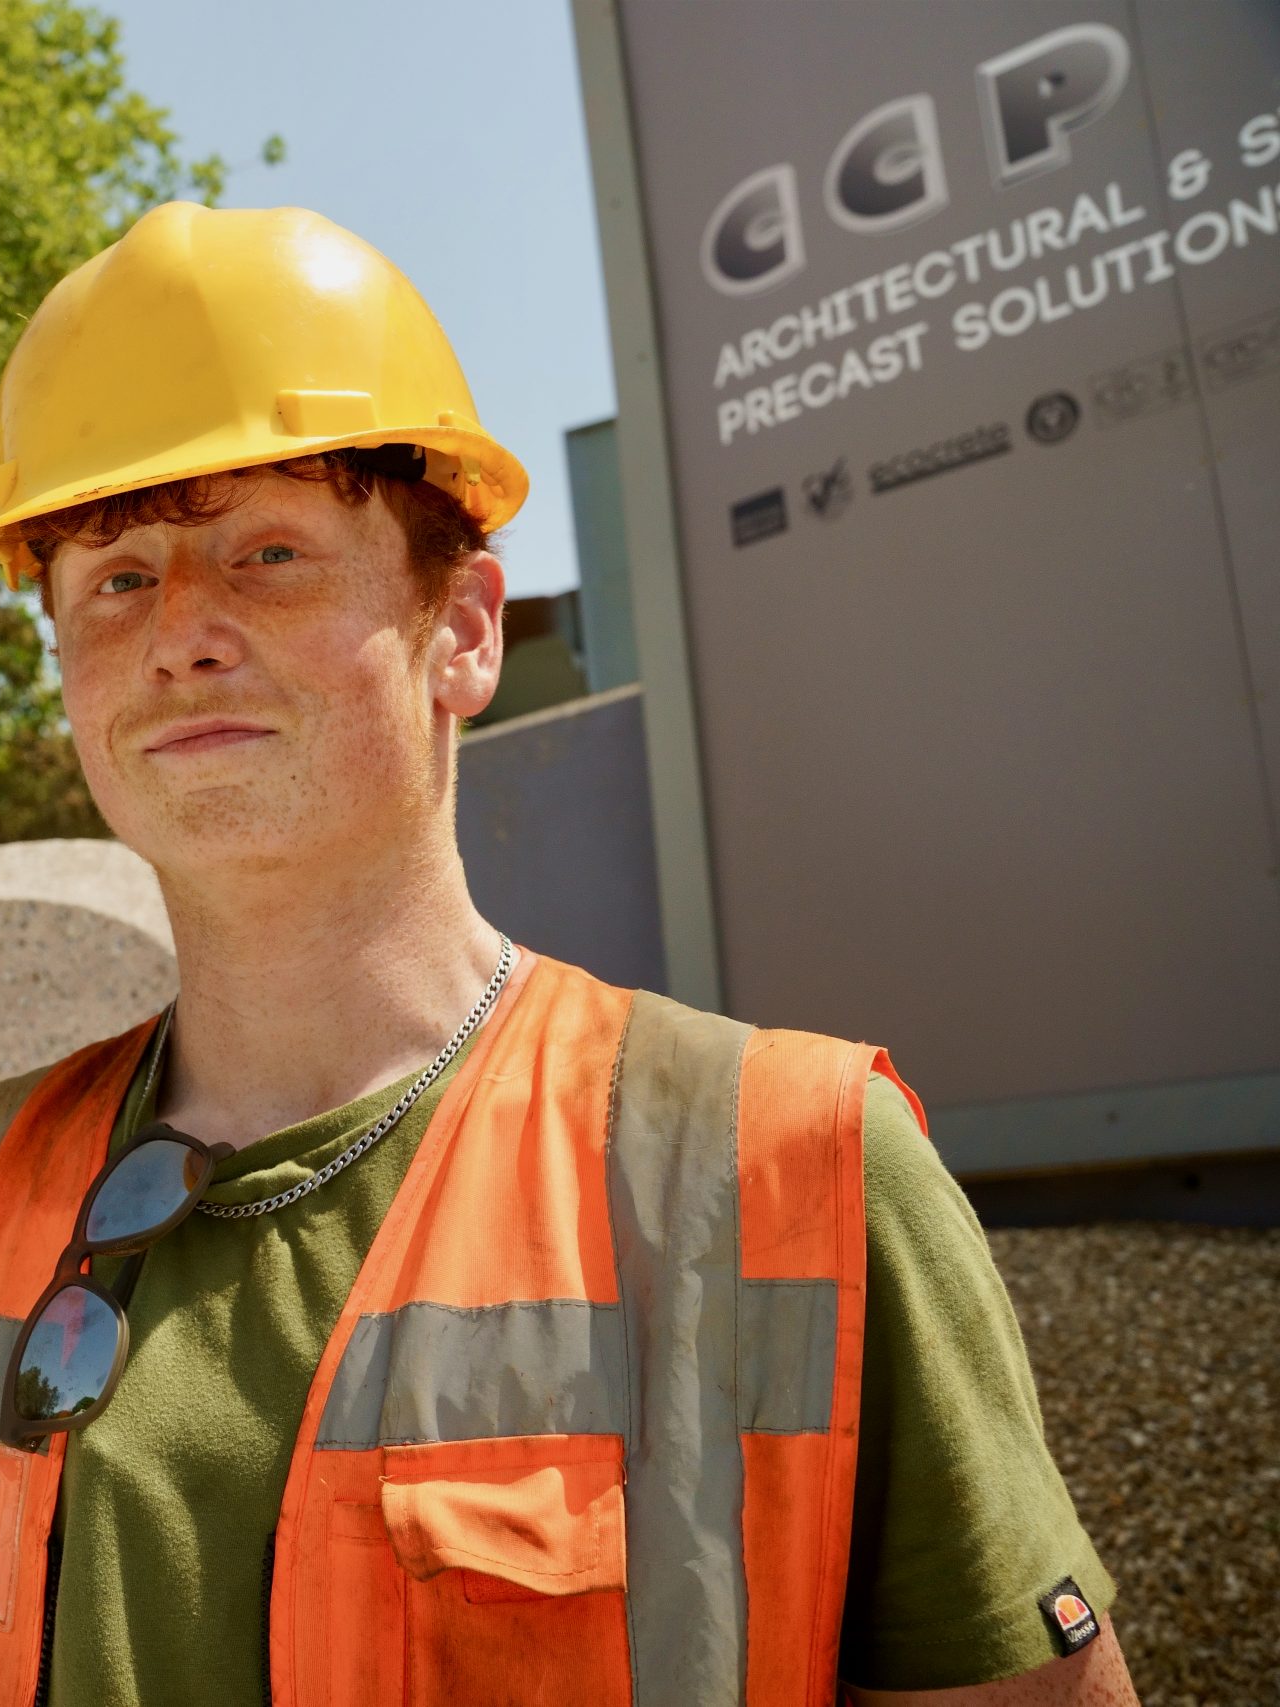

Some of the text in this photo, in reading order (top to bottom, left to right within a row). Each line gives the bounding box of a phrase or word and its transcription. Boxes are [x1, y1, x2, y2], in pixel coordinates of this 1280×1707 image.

[713, 182, 1146, 387] ARCHITECTURAL
[1168, 148, 1212, 200] &
[1238, 107, 1280, 168] S
[717, 322, 928, 444] PRECAST
